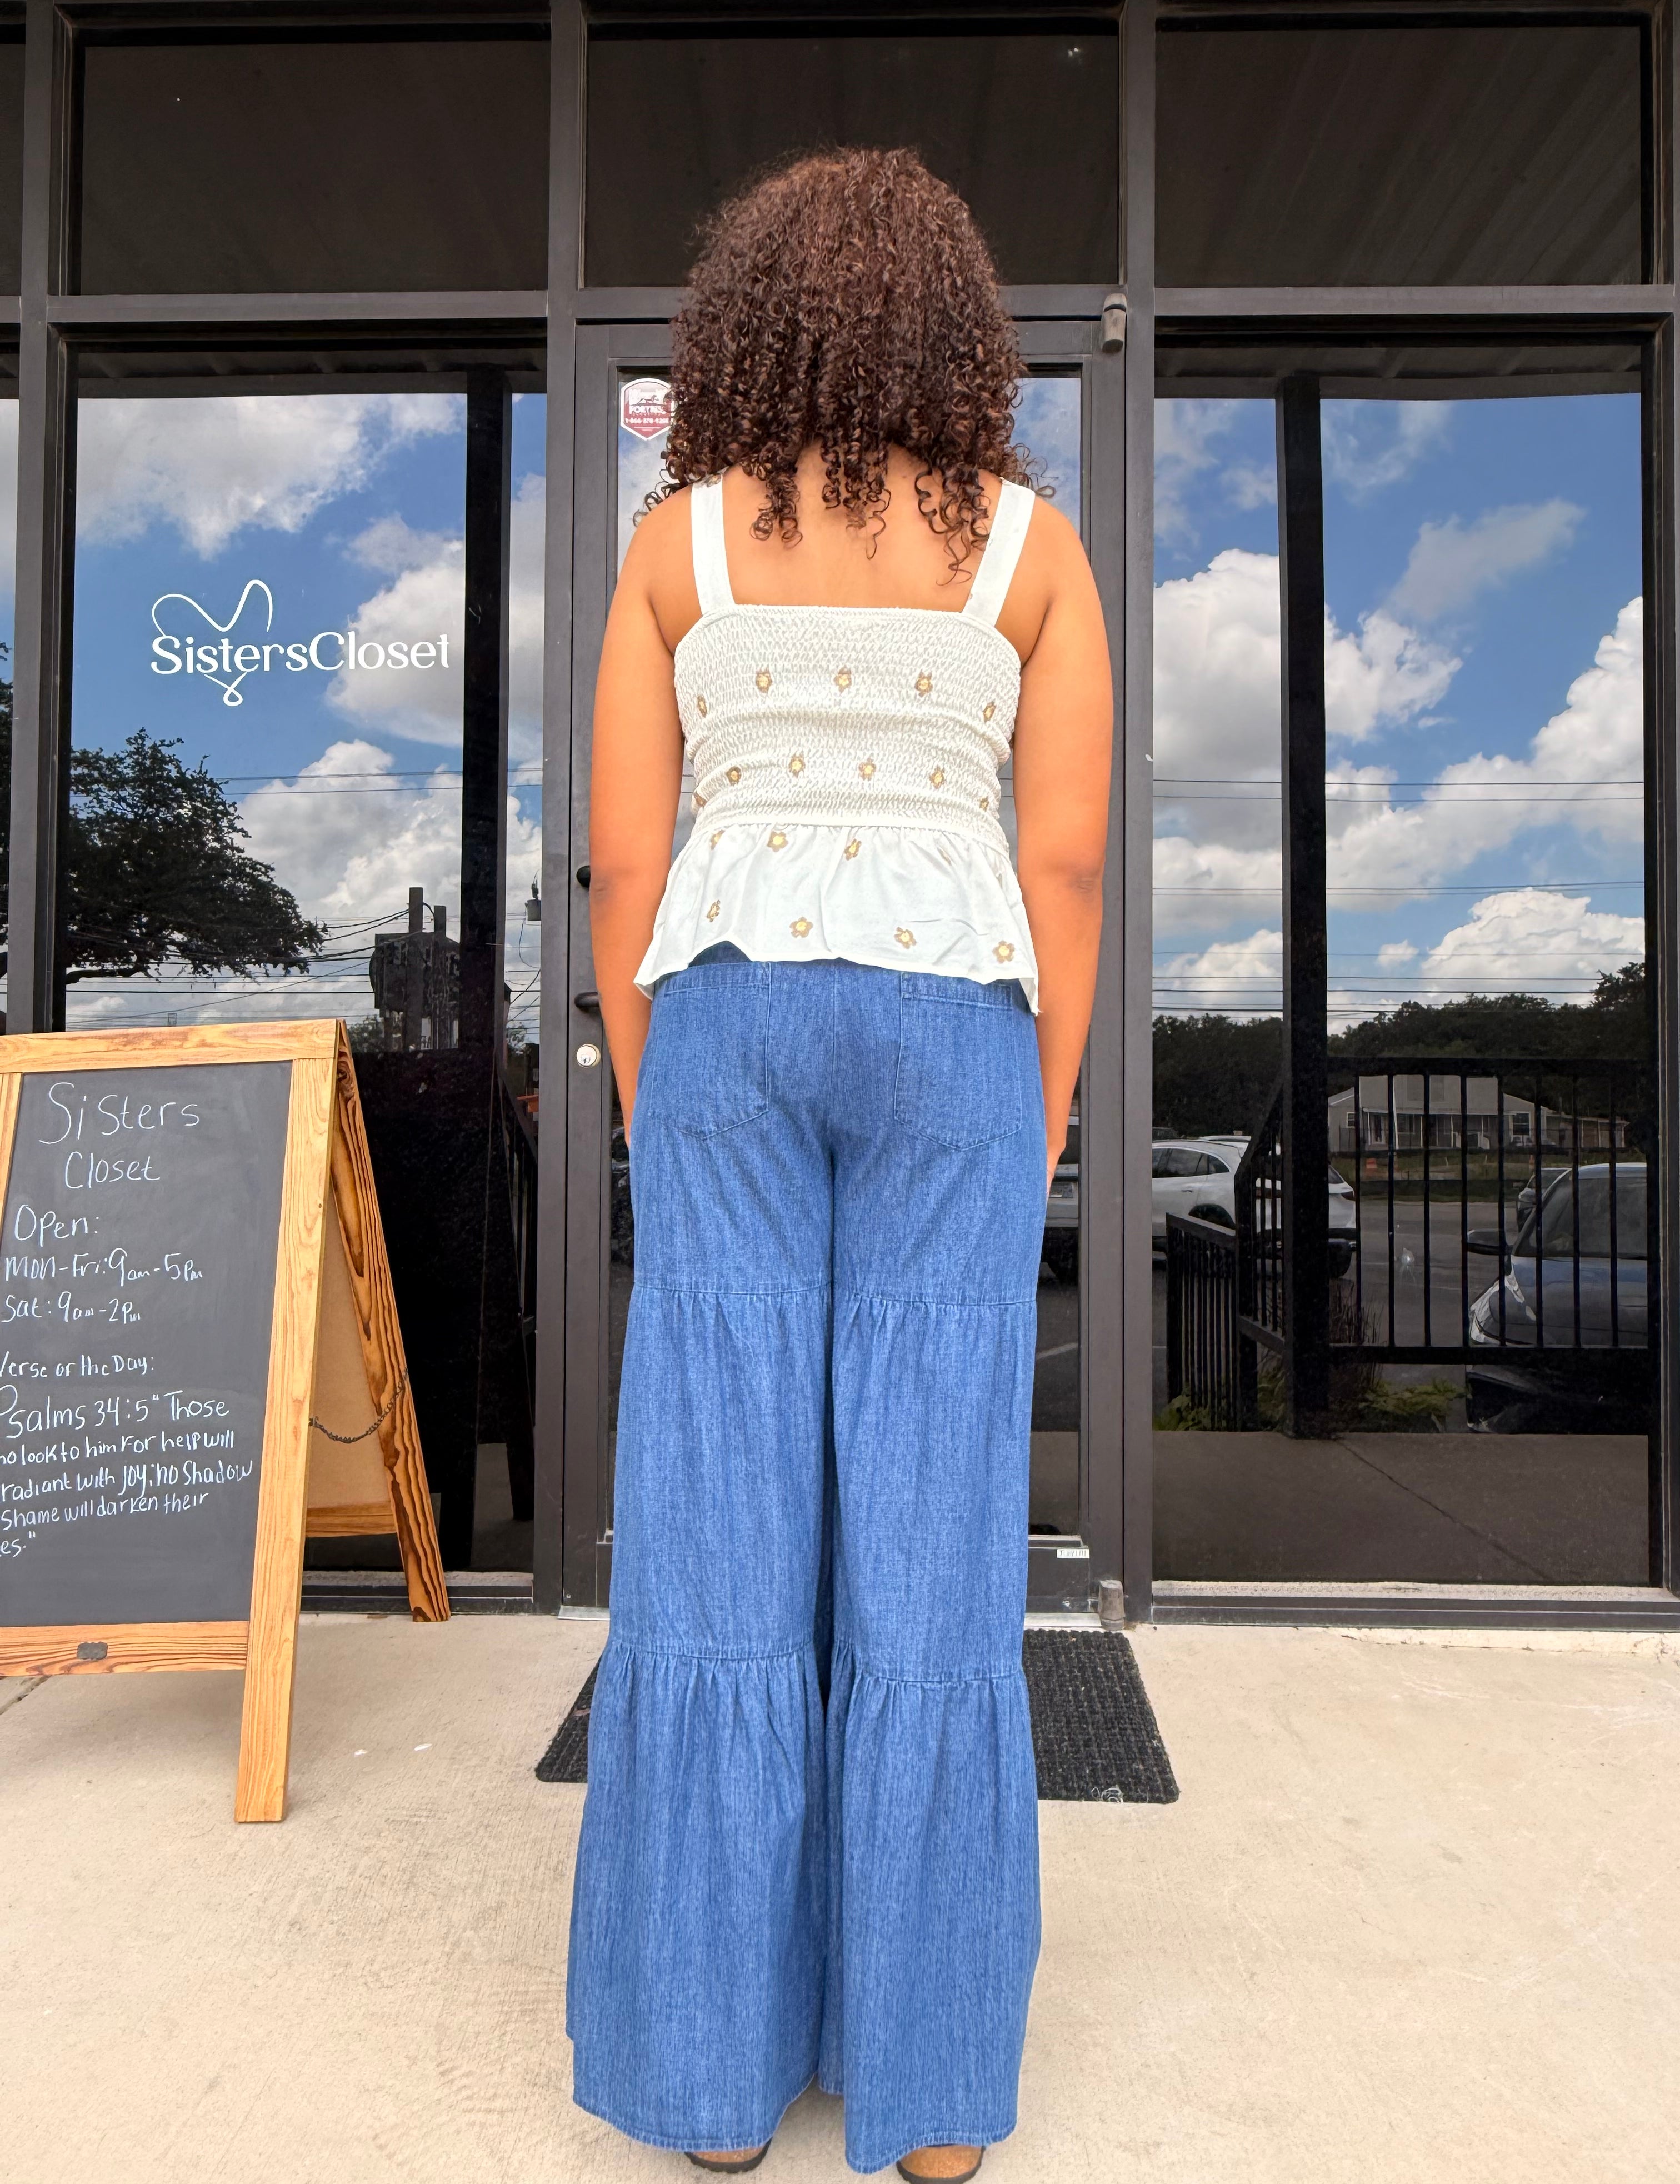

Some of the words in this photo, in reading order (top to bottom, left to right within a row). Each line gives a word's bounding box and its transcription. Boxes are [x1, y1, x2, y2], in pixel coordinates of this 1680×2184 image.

[151, 631, 449, 674] SistersCloset
[64, 1151, 161, 1188] Closet
[81, 1354, 111, 1376] the
[111, 1355, 154, 1375] Day:
[61, 1442, 80, 1462] to
[86, 1436, 117, 1458] him
[203, 1430, 234, 1448] will
[2, 1472, 72, 1501] radiant
[77, 1467, 116, 1491] with
[64, 1499, 93, 1522] will
[163, 1492, 209, 1515] their
